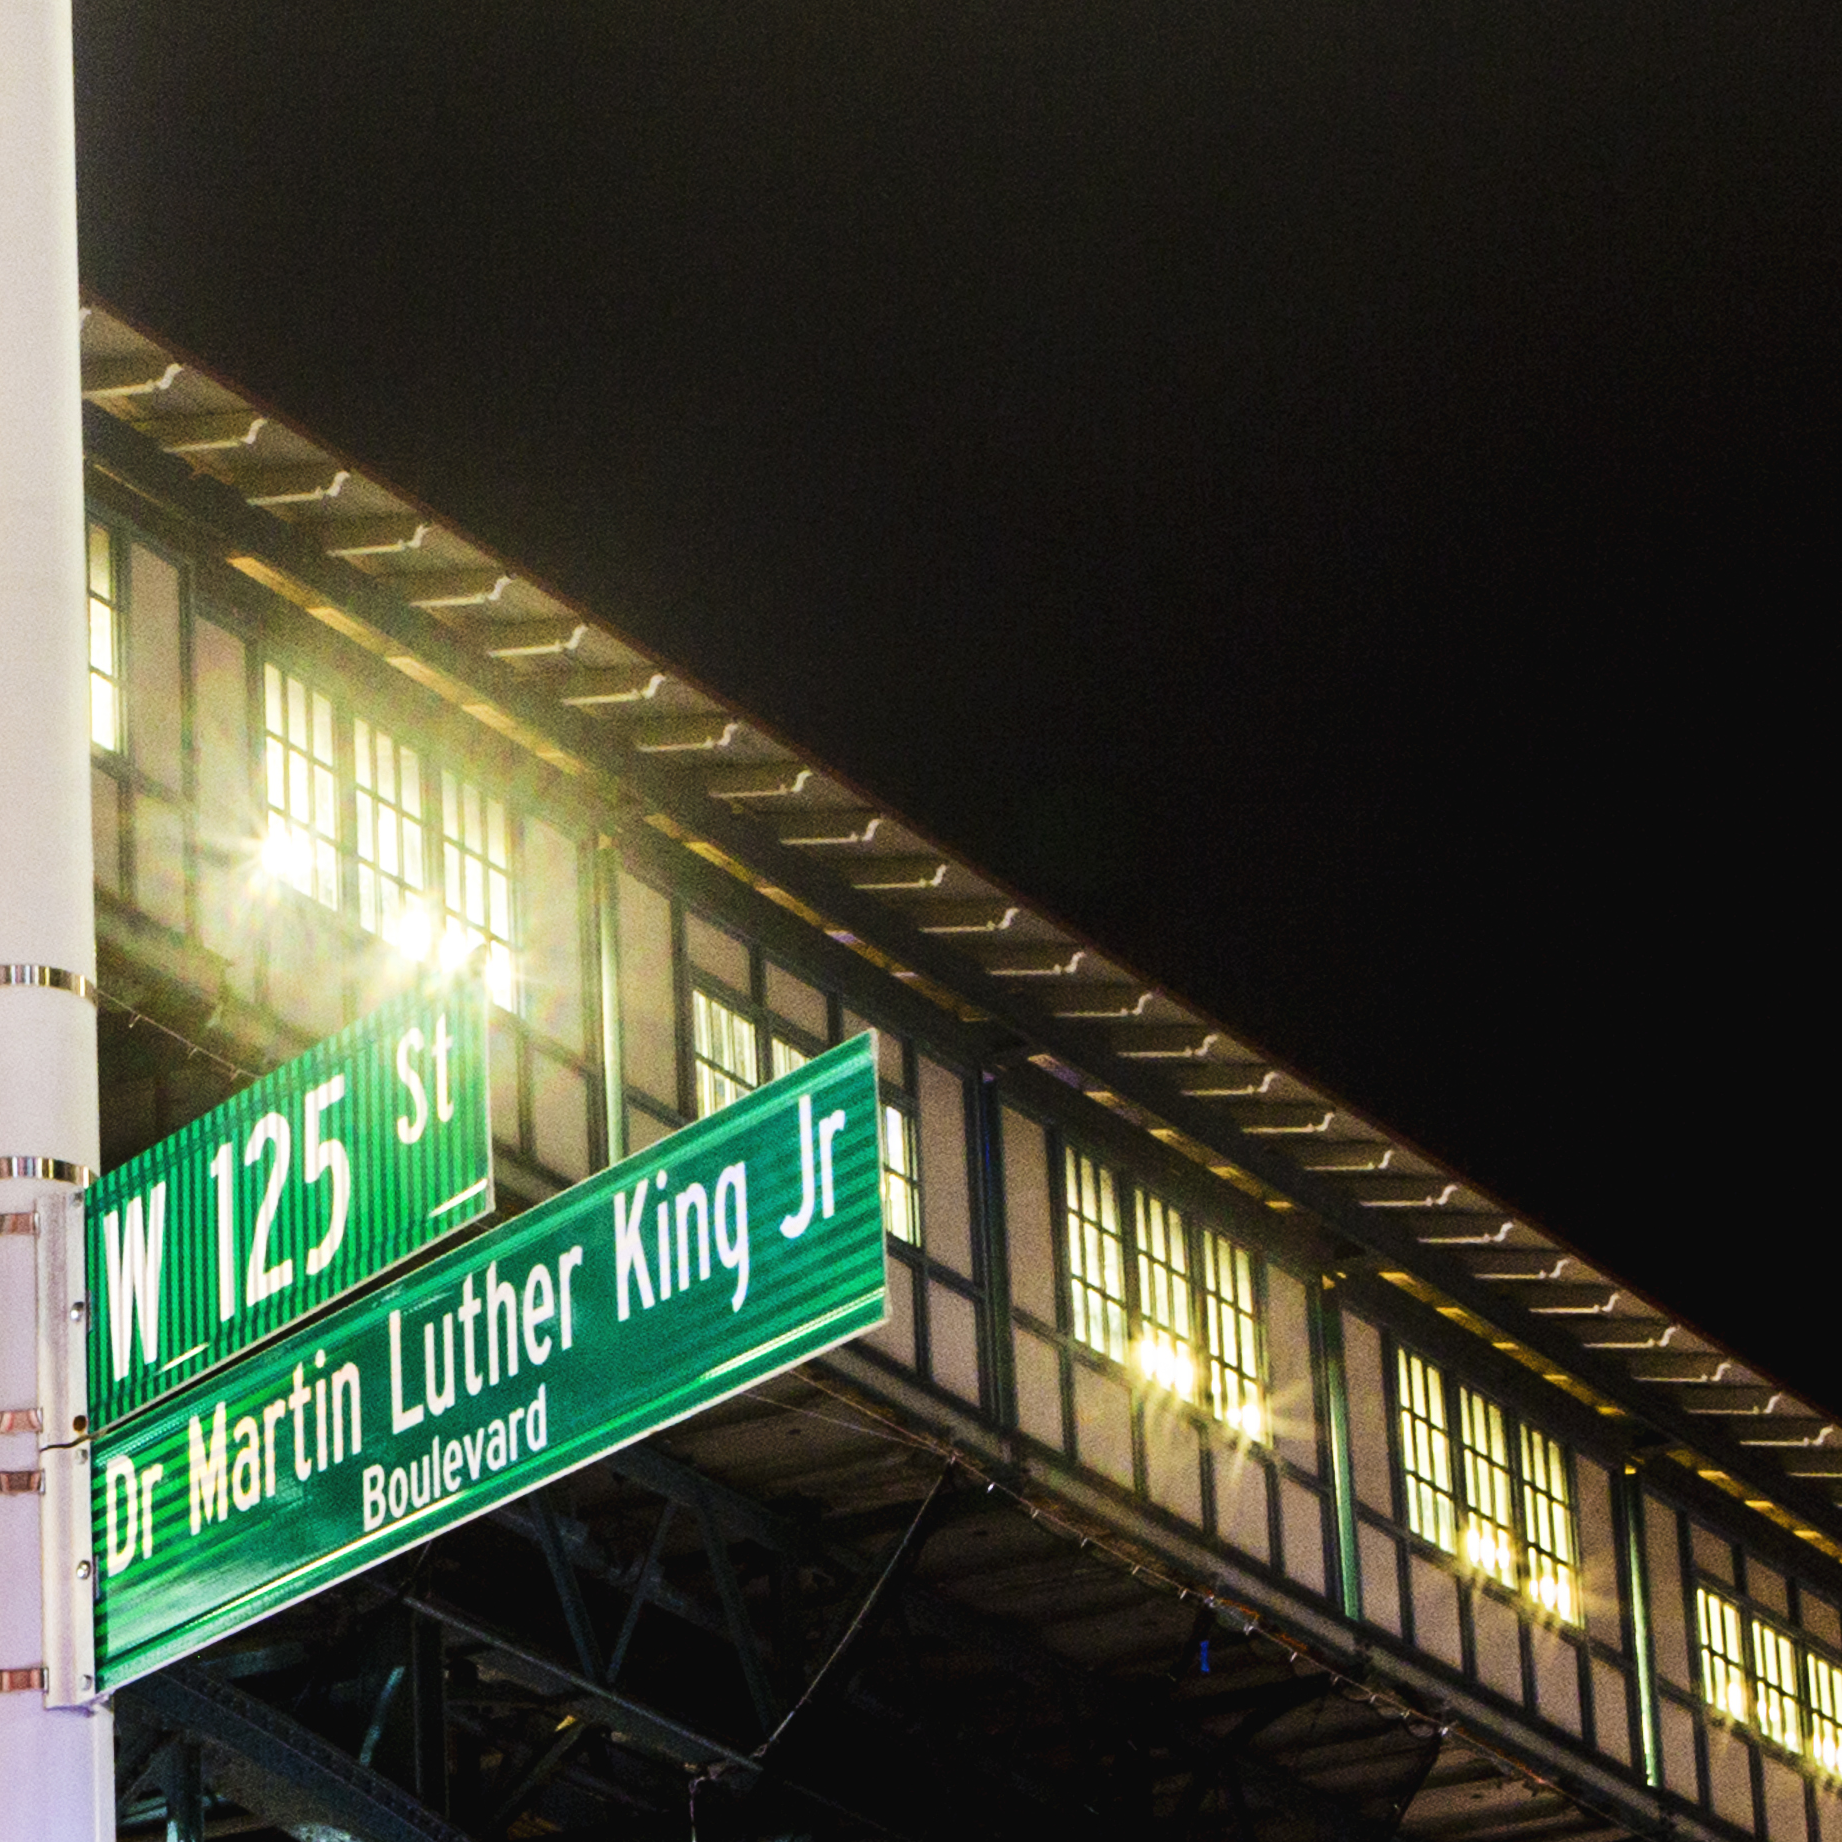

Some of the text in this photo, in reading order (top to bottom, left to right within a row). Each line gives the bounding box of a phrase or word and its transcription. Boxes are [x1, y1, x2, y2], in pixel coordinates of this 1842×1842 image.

[103, 1012, 455, 1382] W 125 St
[105, 1093, 846, 1578] Dr Martin Luther King Jr
[362, 1382, 549, 1533] Boulevard
